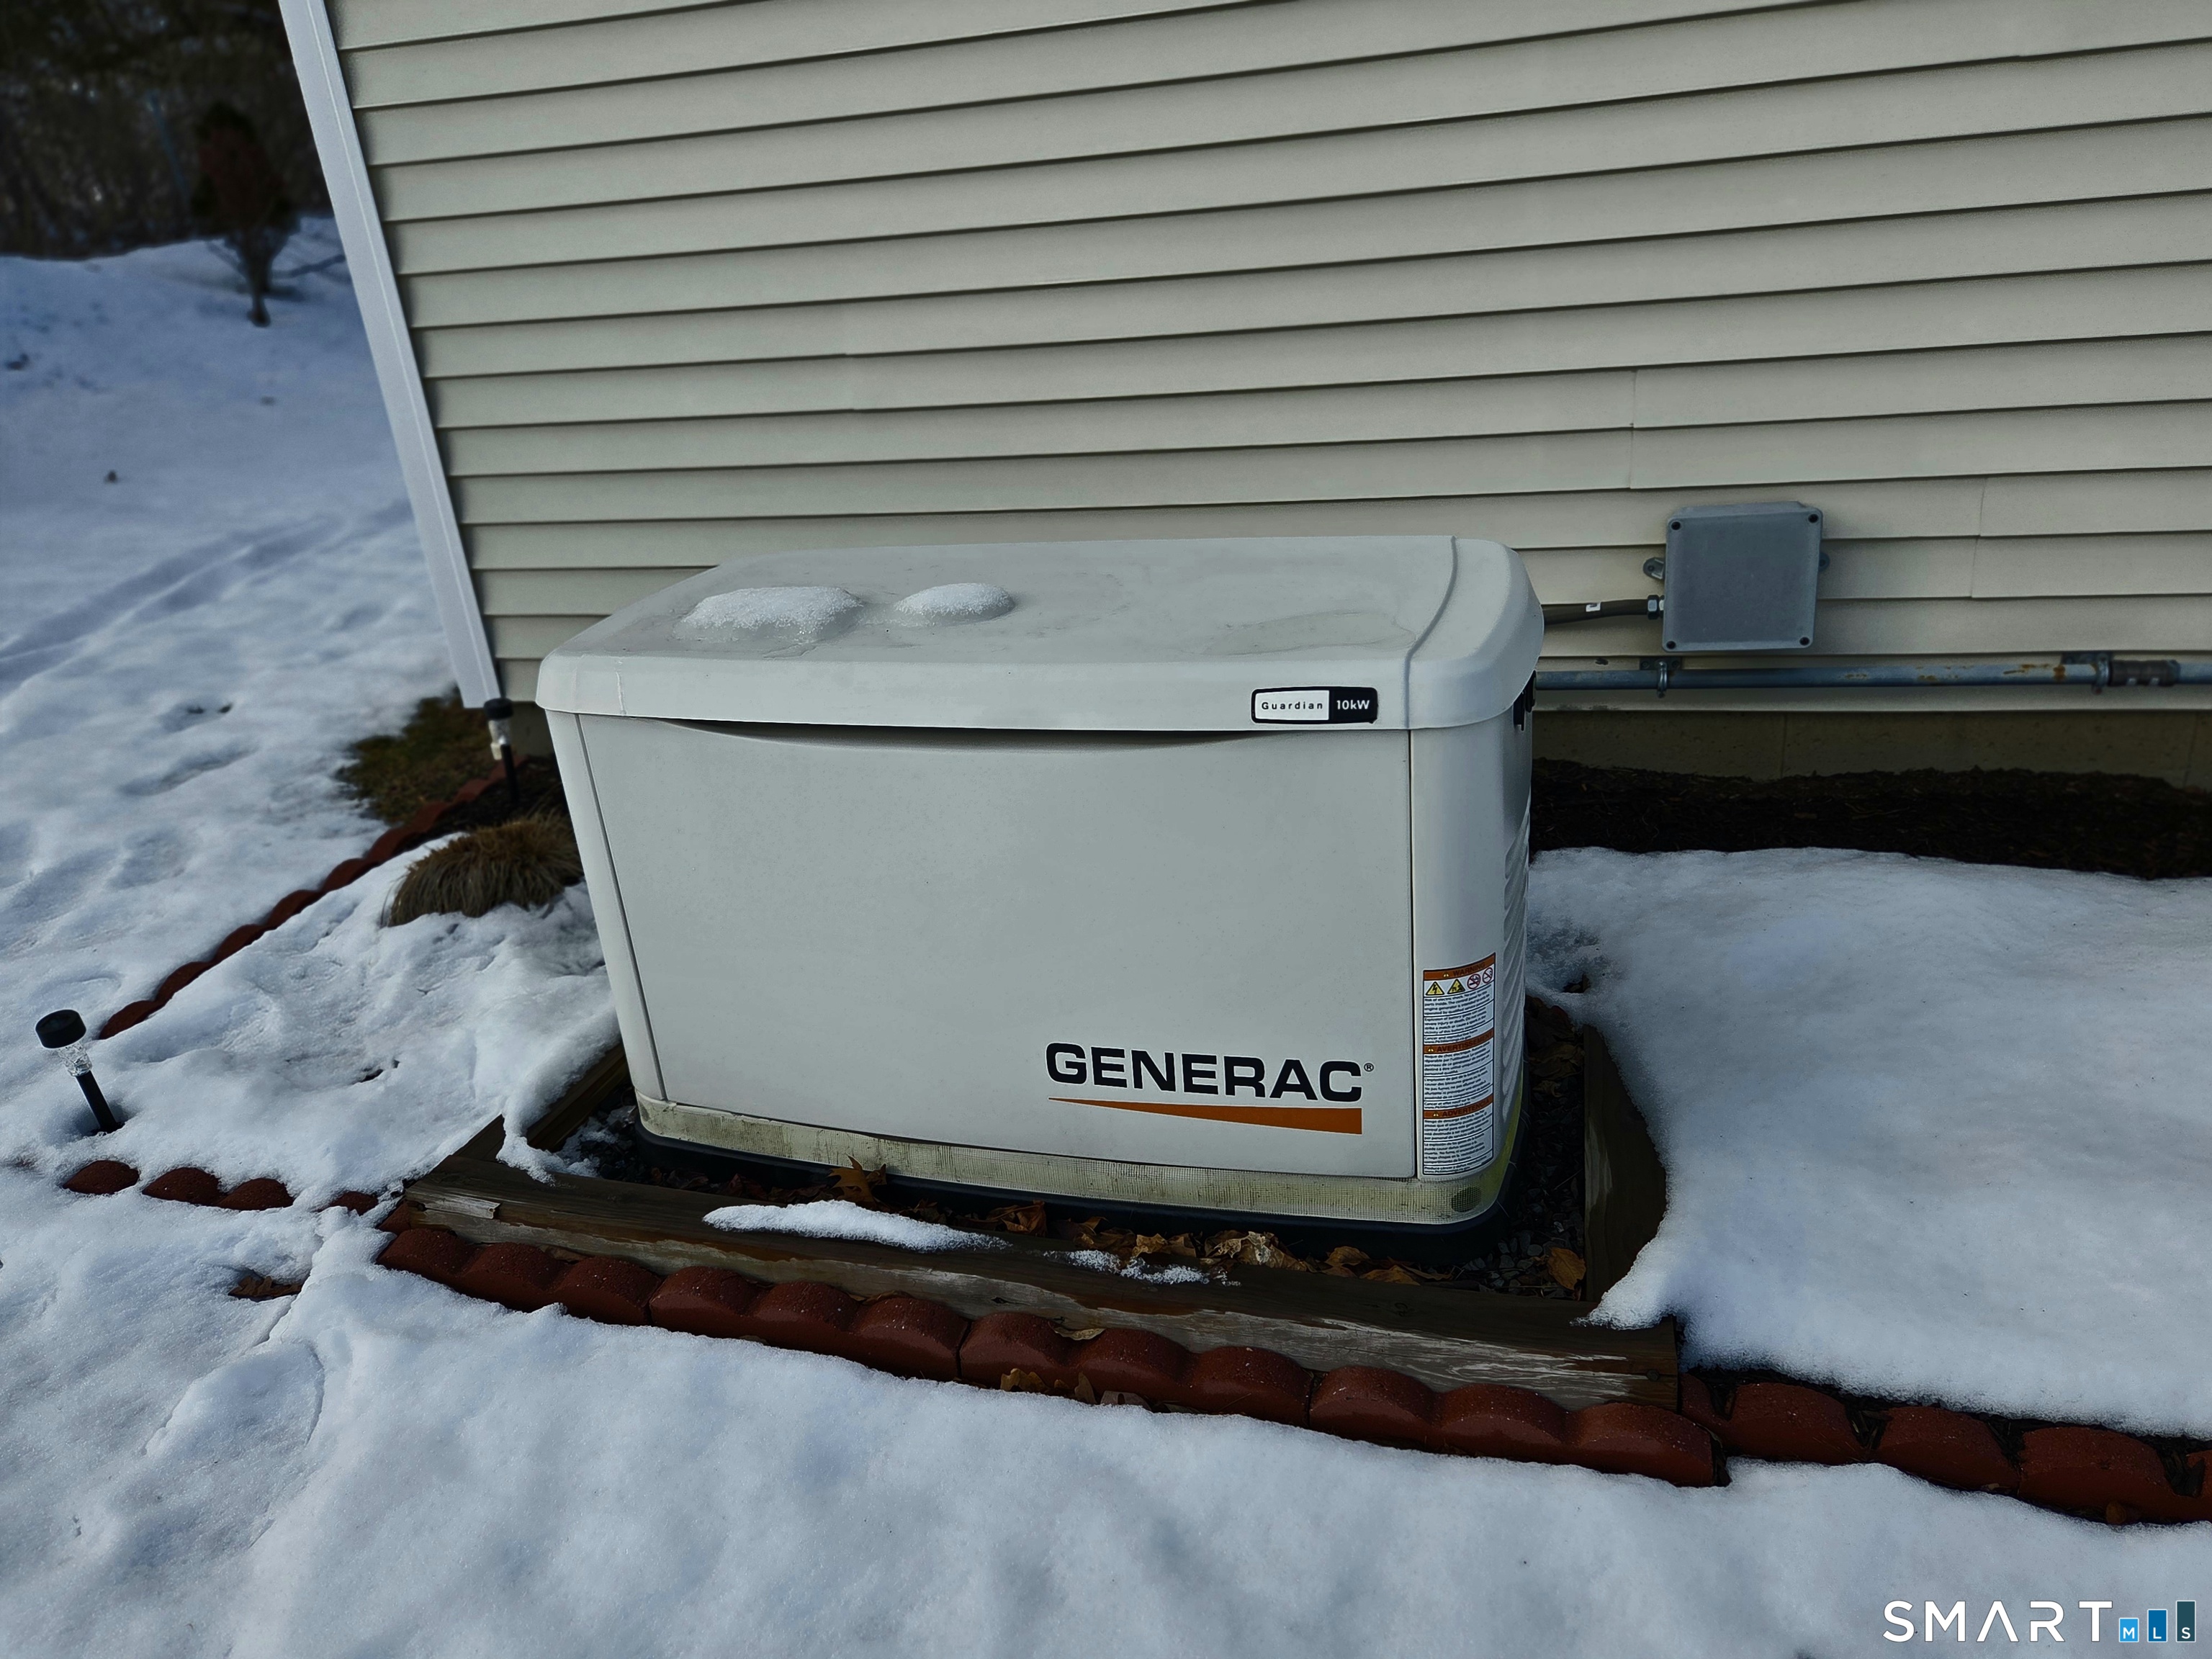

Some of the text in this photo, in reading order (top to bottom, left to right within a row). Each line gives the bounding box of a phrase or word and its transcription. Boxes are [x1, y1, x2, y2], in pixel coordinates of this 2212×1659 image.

[1261, 699, 1370, 710] Guardian 10kW
[1437, 1031, 1493, 1052] AVERTISSEMENT
[1442, 1099, 1490, 1117] ADVERTENCIA
